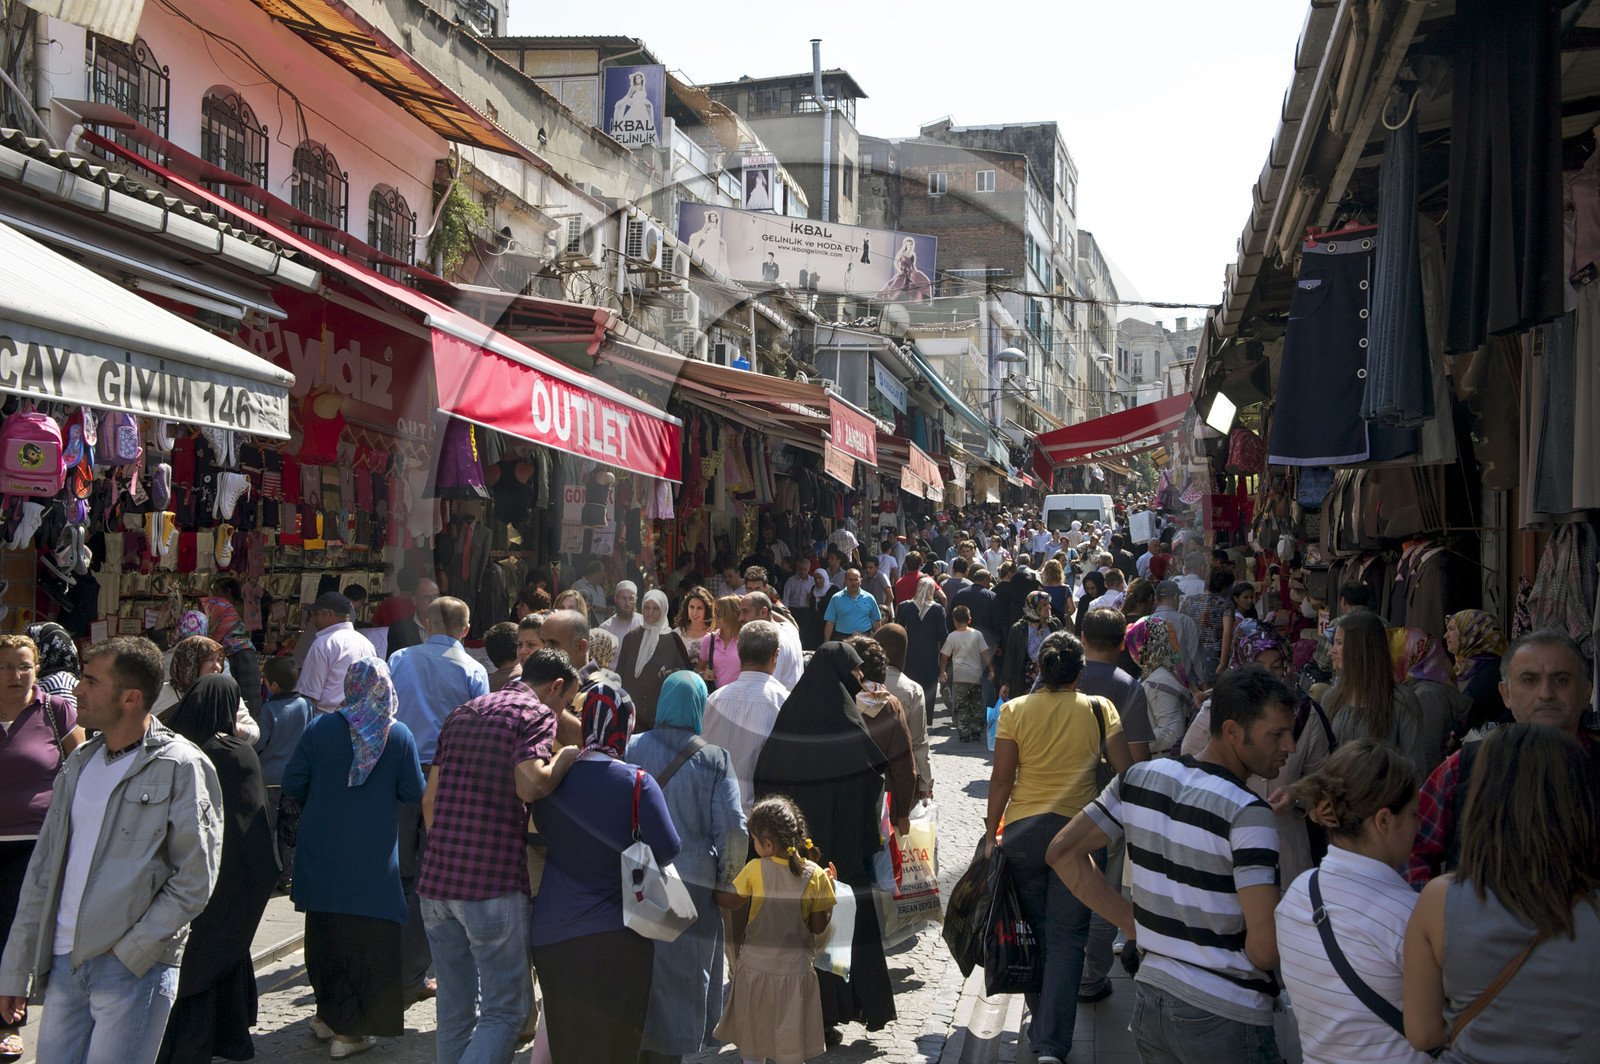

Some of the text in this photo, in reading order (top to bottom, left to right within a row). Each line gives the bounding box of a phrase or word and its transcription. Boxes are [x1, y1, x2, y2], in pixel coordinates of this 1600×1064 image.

[816, 242, 843, 252] MODA
[202, 383, 251, 429] 146
[531, 378, 631, 460] OUTLET
